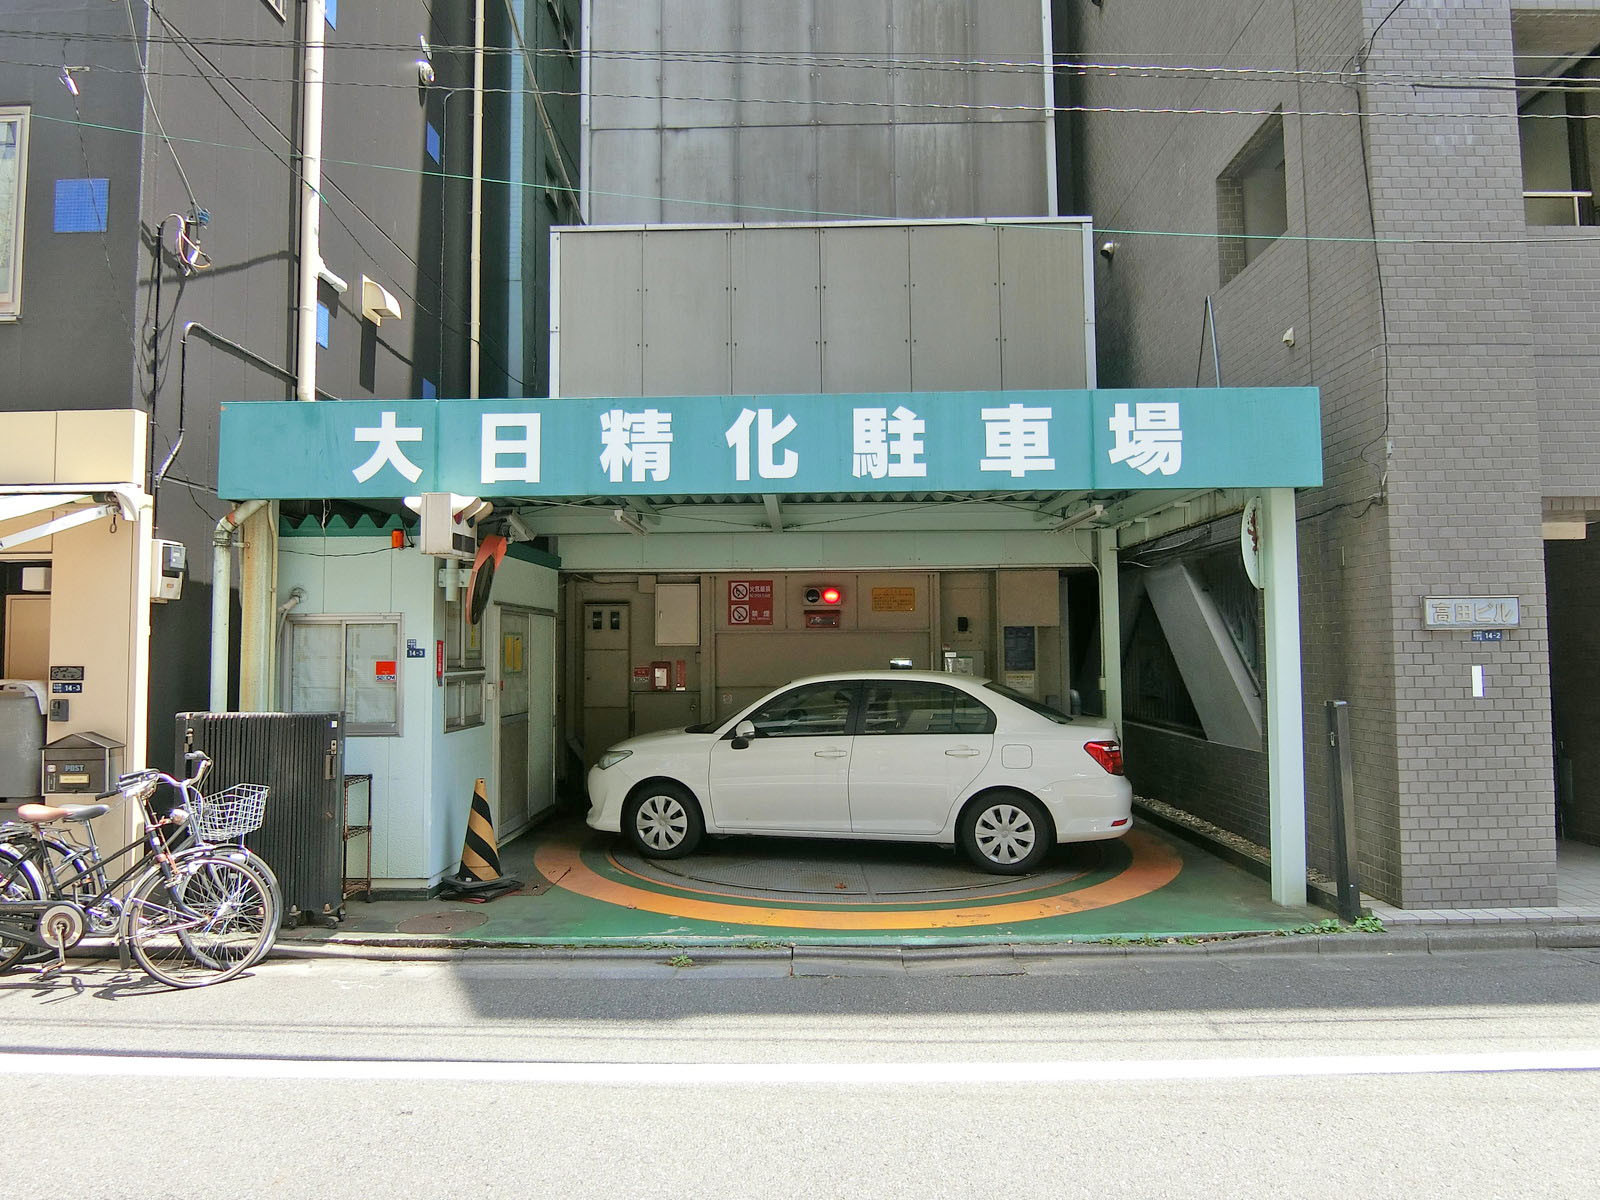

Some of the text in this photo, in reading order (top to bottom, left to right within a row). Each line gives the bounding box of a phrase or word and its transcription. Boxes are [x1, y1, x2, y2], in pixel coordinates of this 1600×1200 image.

[352, 402, 1183, 484] 大日精化駐車場
[1431, 602, 1513, 623] 高田ビル
[64, 684, 81, 692] 14-3
[64, 764, 85, 772] POST
